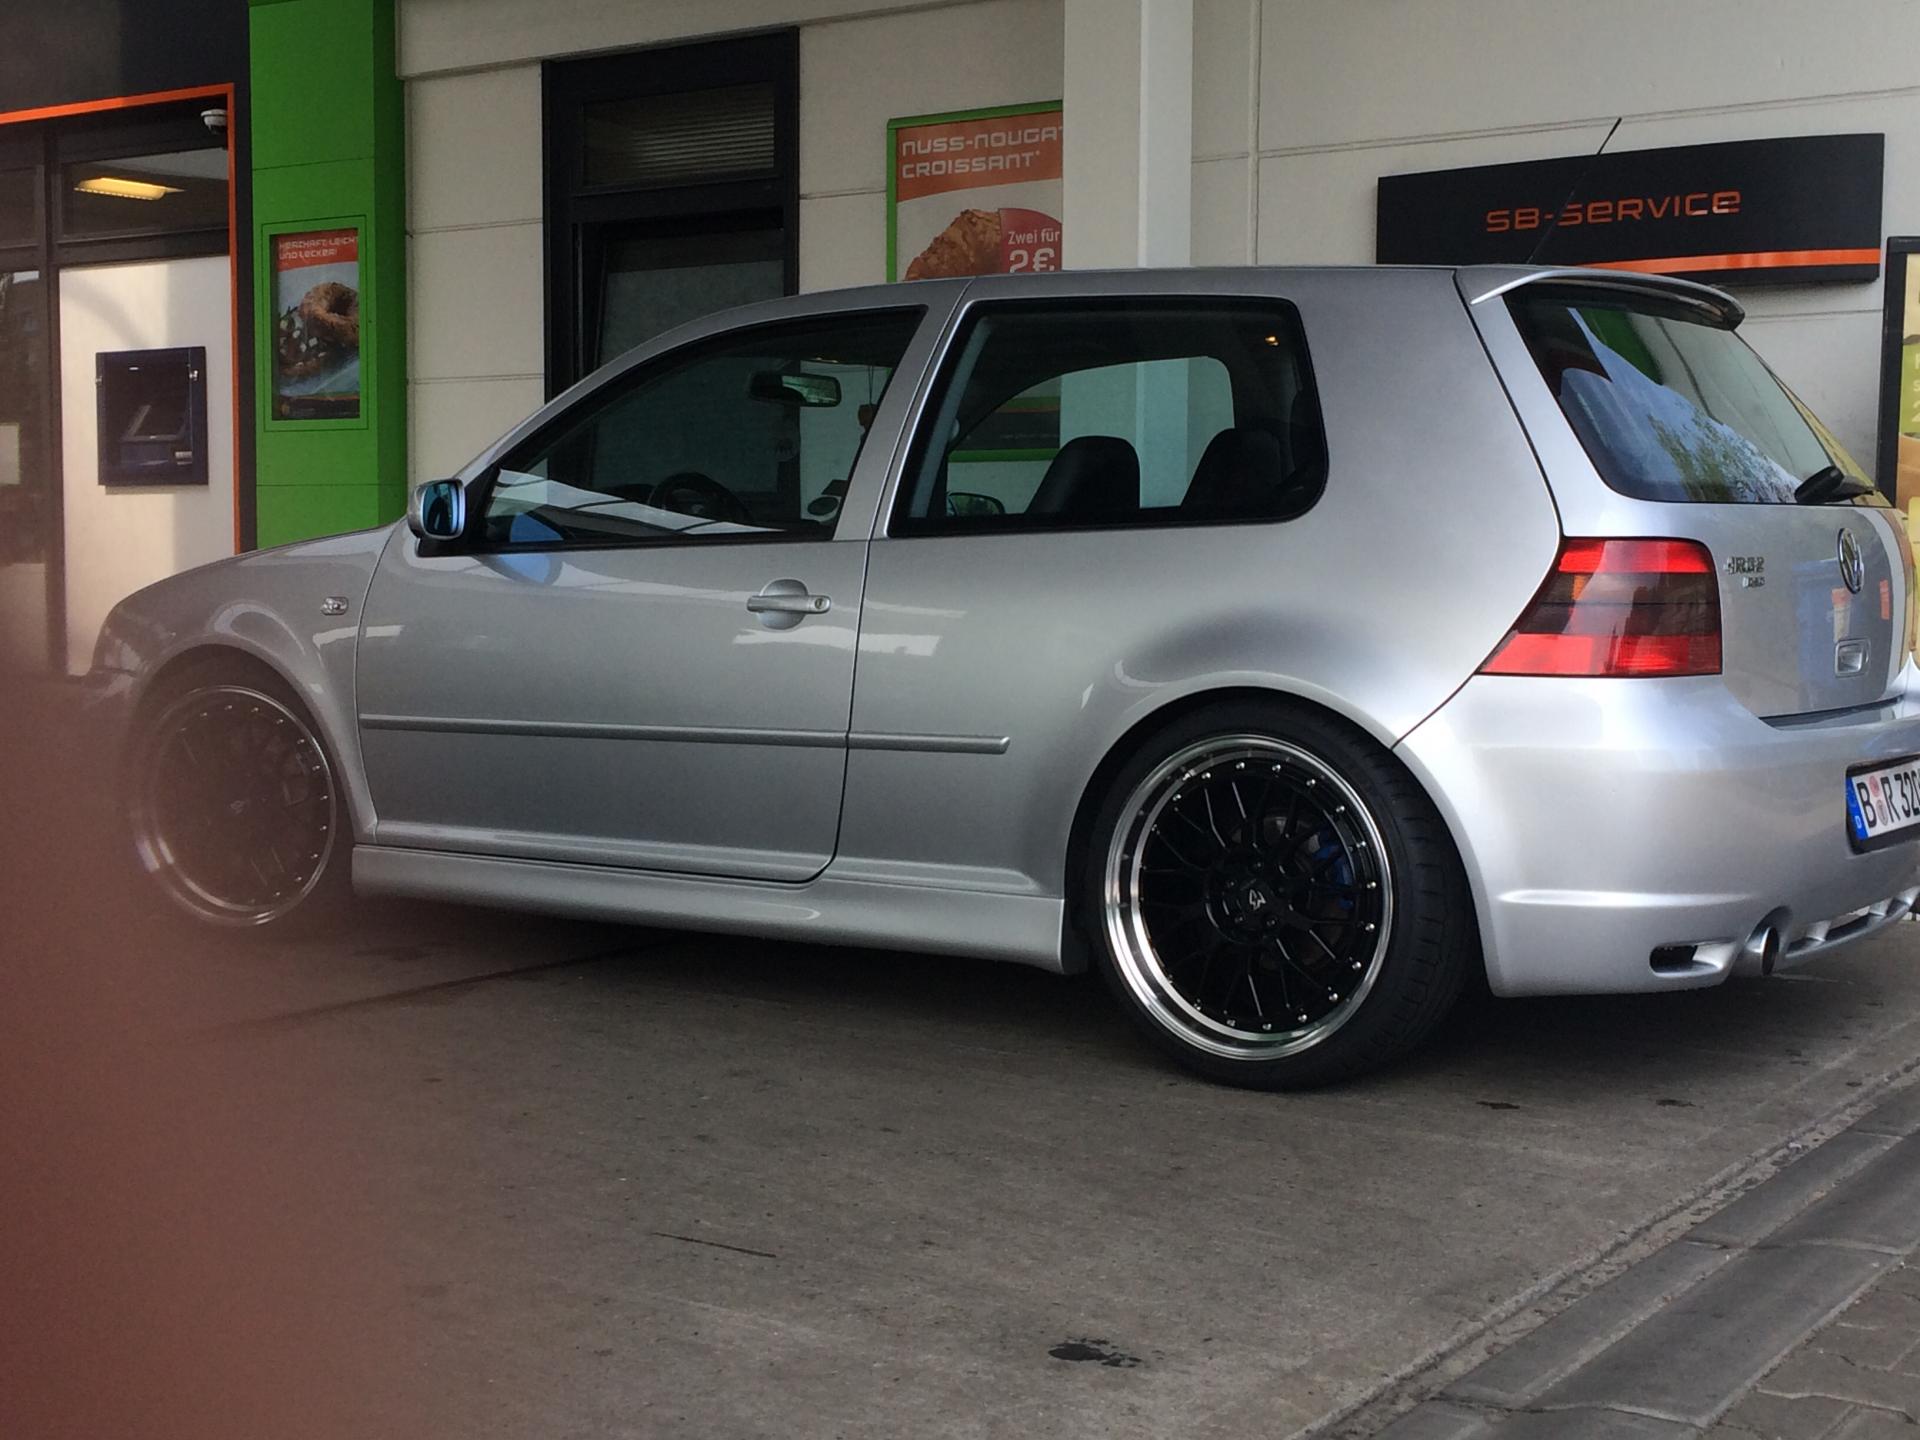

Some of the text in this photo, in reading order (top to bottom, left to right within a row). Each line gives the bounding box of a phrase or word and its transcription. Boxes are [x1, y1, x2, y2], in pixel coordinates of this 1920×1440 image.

[902, 126, 1063, 157] NUSS-NOUGA
[1486, 191, 1741, 232] SB-SERVICE
[1008, 228, 1060, 245] Zwei für
[1856, 782, 1877, 828] B
[1880, 776, 1901, 823] R
